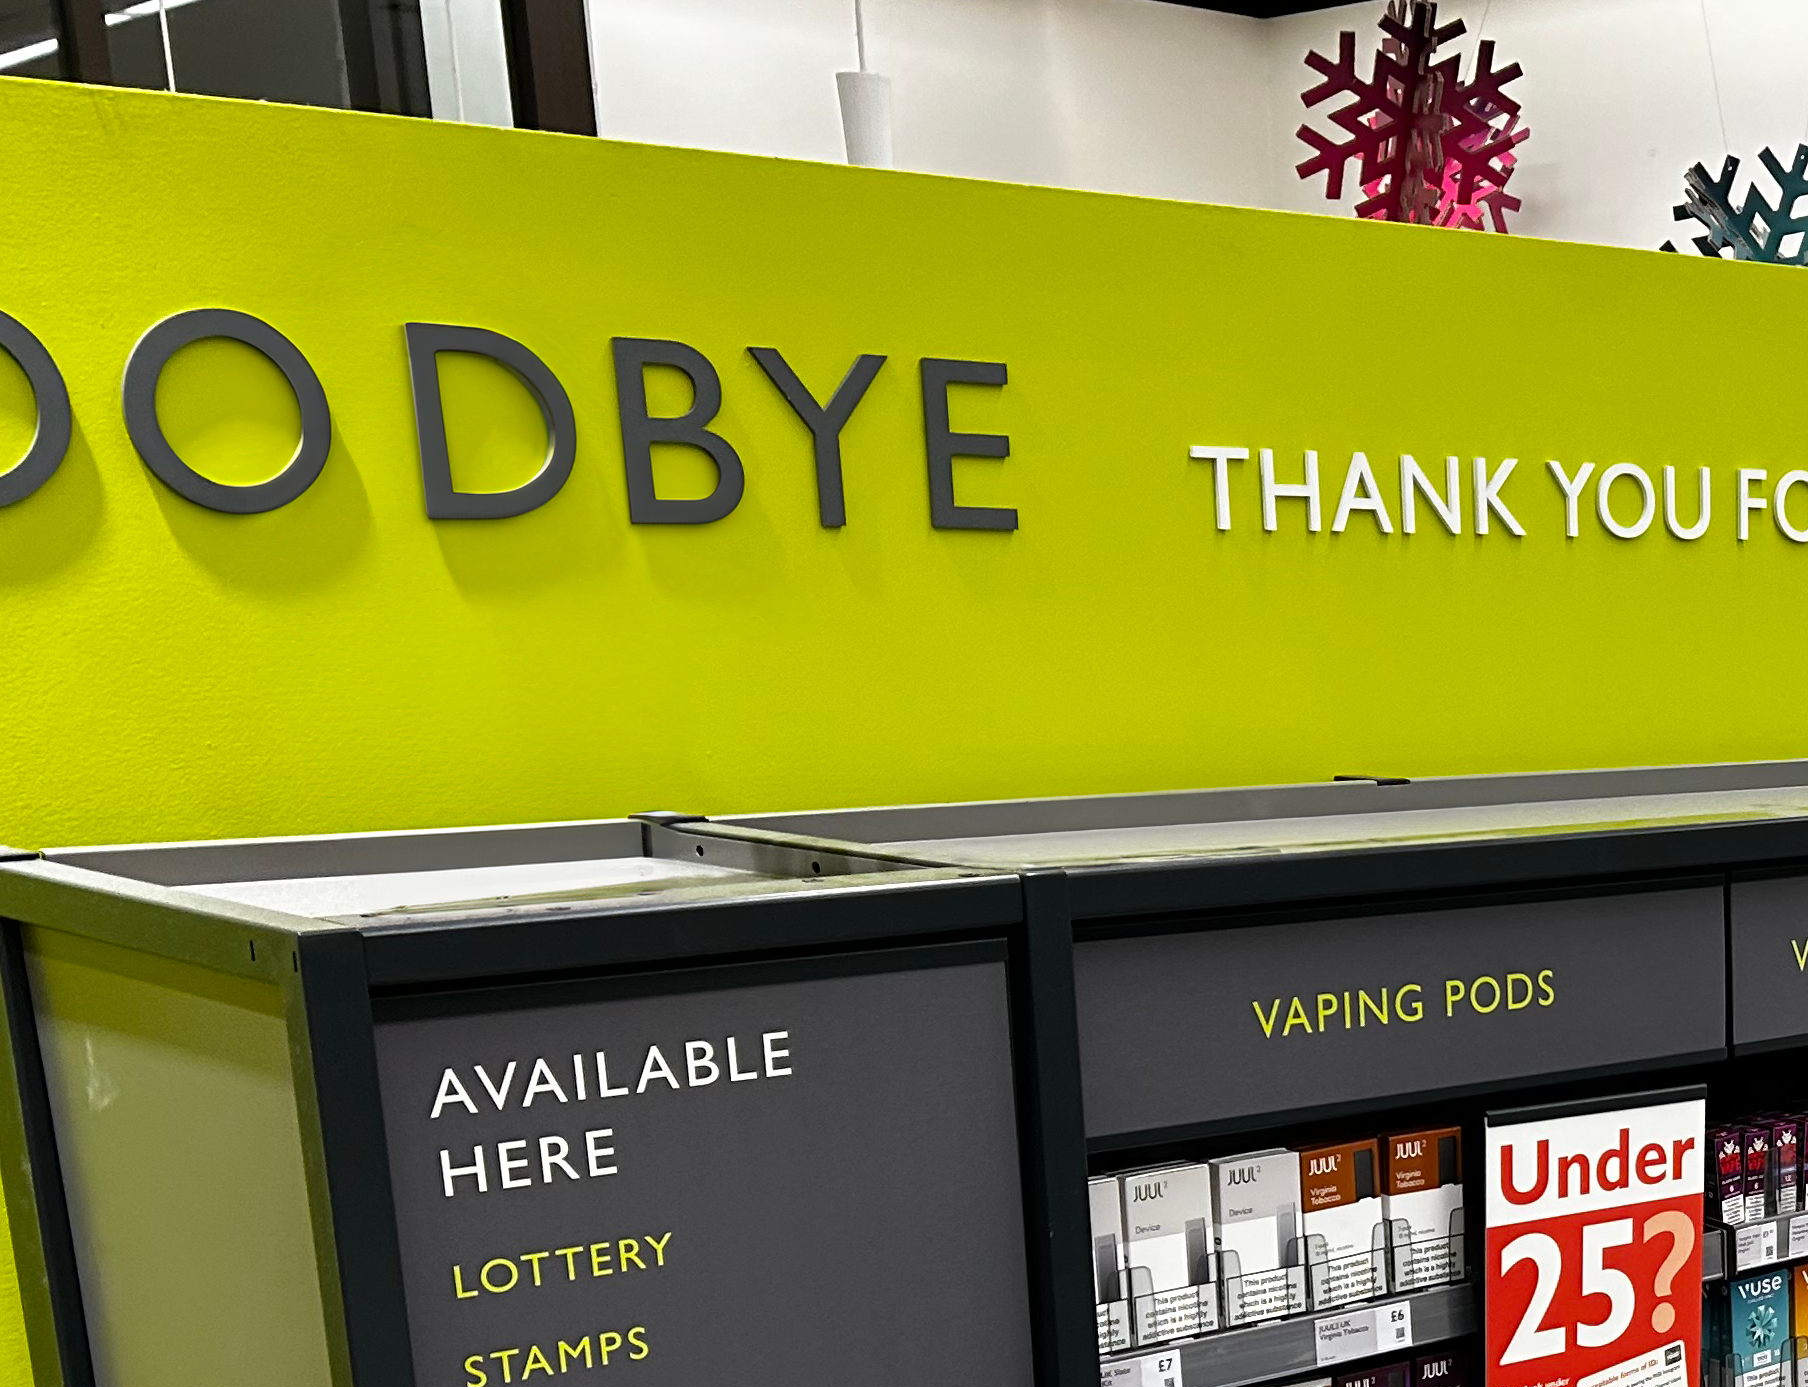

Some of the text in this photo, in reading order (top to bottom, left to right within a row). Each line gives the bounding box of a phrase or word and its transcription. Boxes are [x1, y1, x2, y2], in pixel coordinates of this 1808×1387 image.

[1189, 446, 1527, 537] THANK
[1545, 460, 1712, 541] YOU
[1252, 968, 1557, 1040] VAPING PODS
[430, 1030, 793, 1120] AVAILABLE
[440, 1128, 619, 1198] HERE
[1309, 1184, 1338, 1199] Virginia
[1500, 1128, 1695, 1206] Under
[1228, 1204, 1254, 1218] Device
[1310, 1192, 1342, 1206] Tobacco
[453, 1232, 673, 1299] LOTTERY
[1499, 1210, 1696, 1367] 25?
[1390, 1308, 1405, 1324] £6
[1157, 1357, 1174, 1373] £7
